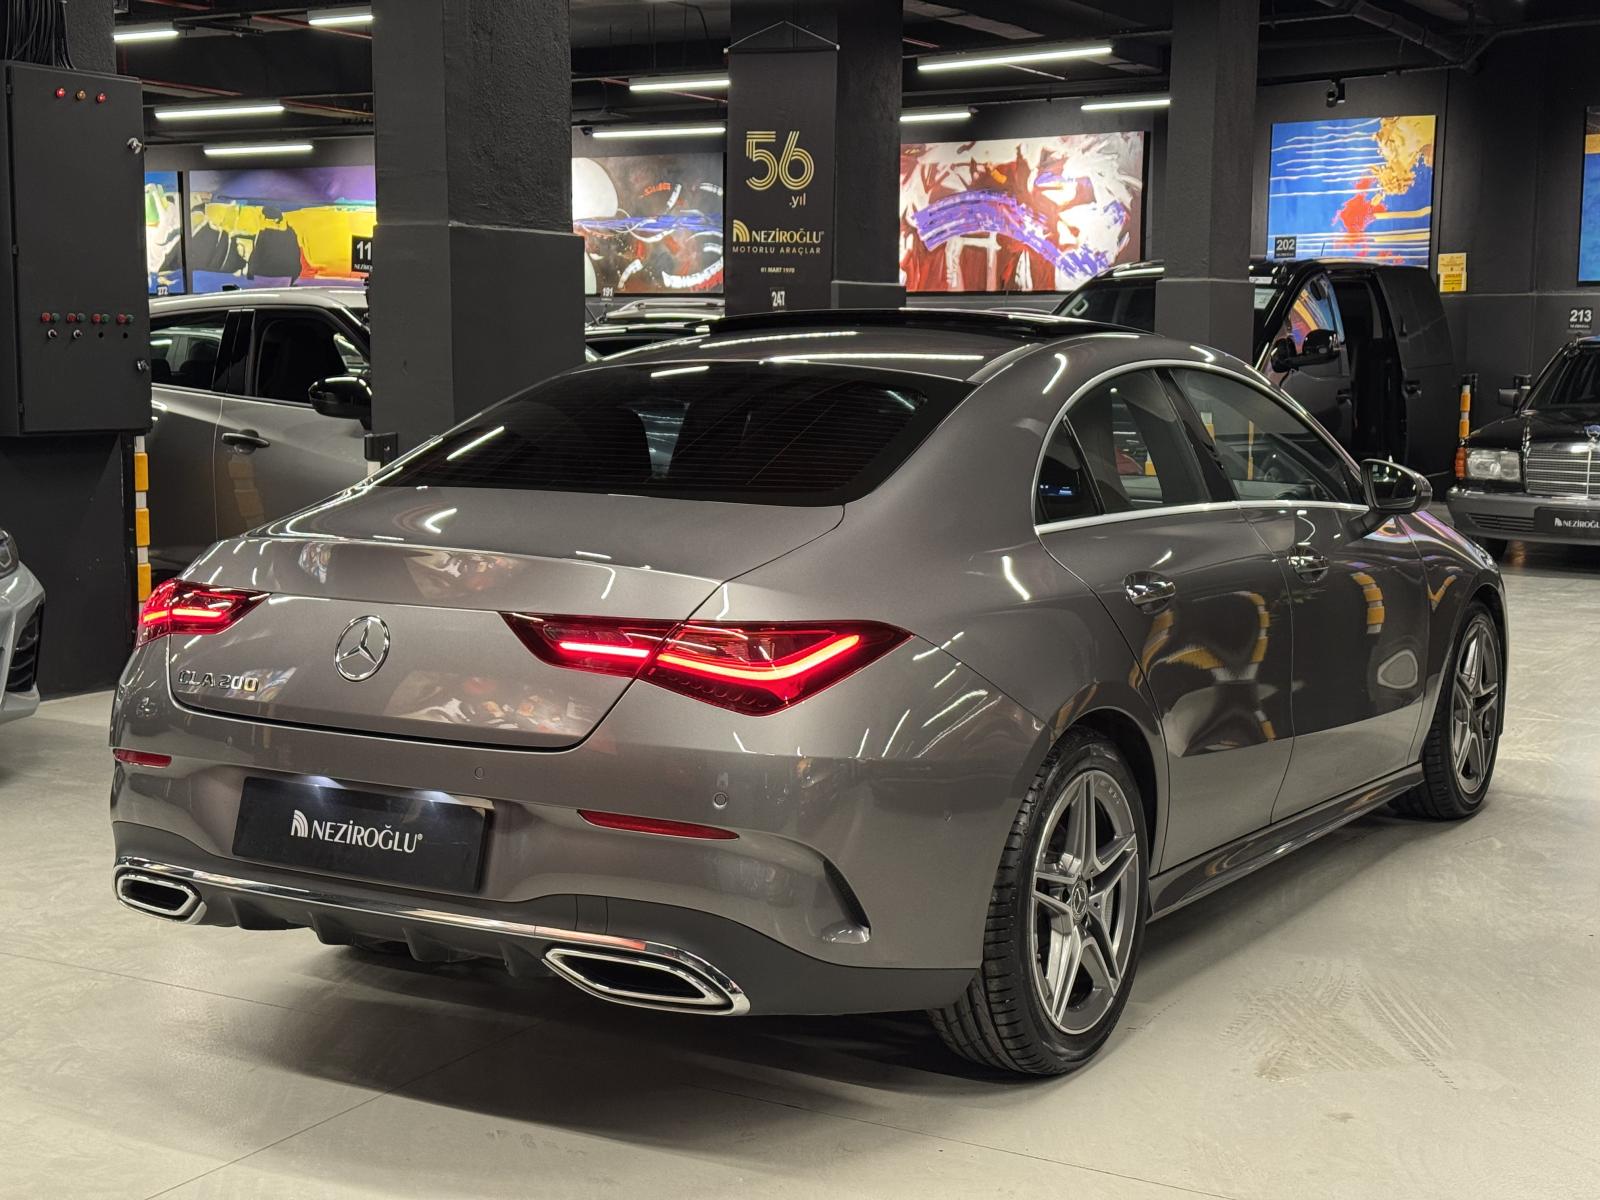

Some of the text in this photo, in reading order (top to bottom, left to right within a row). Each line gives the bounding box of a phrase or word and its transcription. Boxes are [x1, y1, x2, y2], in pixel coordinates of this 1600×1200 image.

[746, 131, 814, 190] 56
[356, 240, 372, 261] 11
[732, 246, 821, 257] MOTORLU ARAÇLAR
[1276, 239, 1295, 251] 202
[771, 291, 785, 307] 247
[1569, 309, 1592, 323] 213
[1563, 520, 1600, 529] NEZİROĞL
[178, 670, 258, 691] CLA 200
